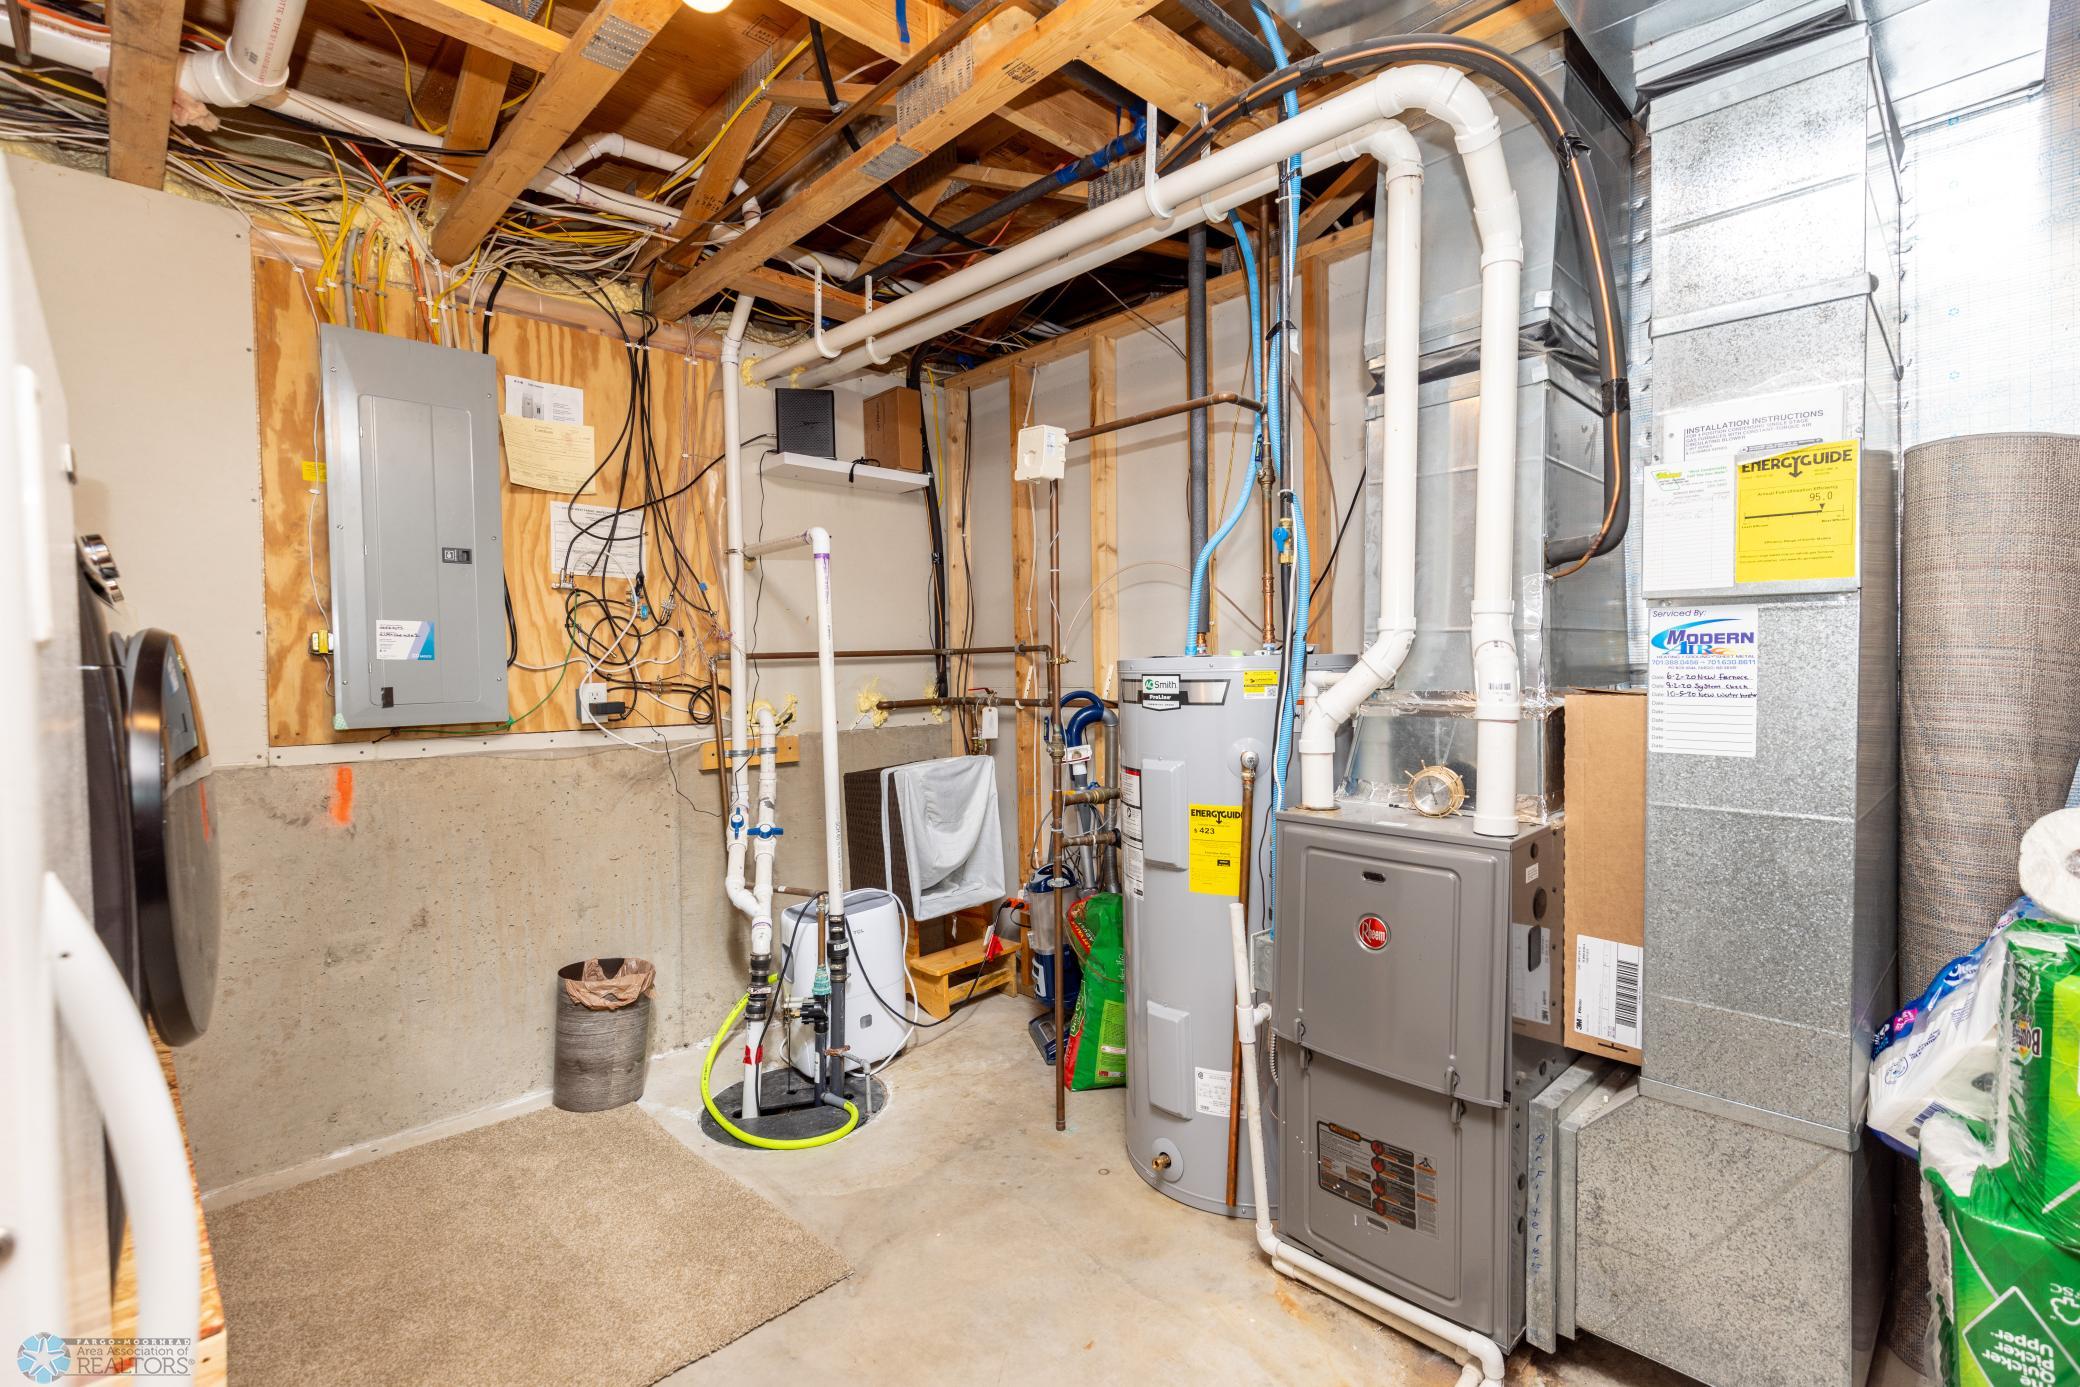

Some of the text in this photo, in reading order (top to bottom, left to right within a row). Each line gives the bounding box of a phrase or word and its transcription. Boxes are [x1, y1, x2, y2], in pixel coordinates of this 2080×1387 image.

[1686, 409, 1824, 434] INSTALLATION INSTRUCTIONS
[1741, 450, 1853, 475] ENERGYGUIDE
[1809, 491, 1833, 502] 95.0
[1652, 609, 1707, 618] Serviced By:
[1667, 629, 1755, 645] MODERN
[1154, 680, 1177, 690] Smith
[1694, 682, 1721, 692] System
[1191, 809, 1243, 820] ENERGYGUID
[1361, 919, 1386, 943] Rheem
[1576, 1018, 1583, 1030] 3M
[1994, 1329, 2054, 1358] Upper
[1995, 1341, 2055, 1372] Picker
[1982, 1350, 2056, 1385] Quicker
